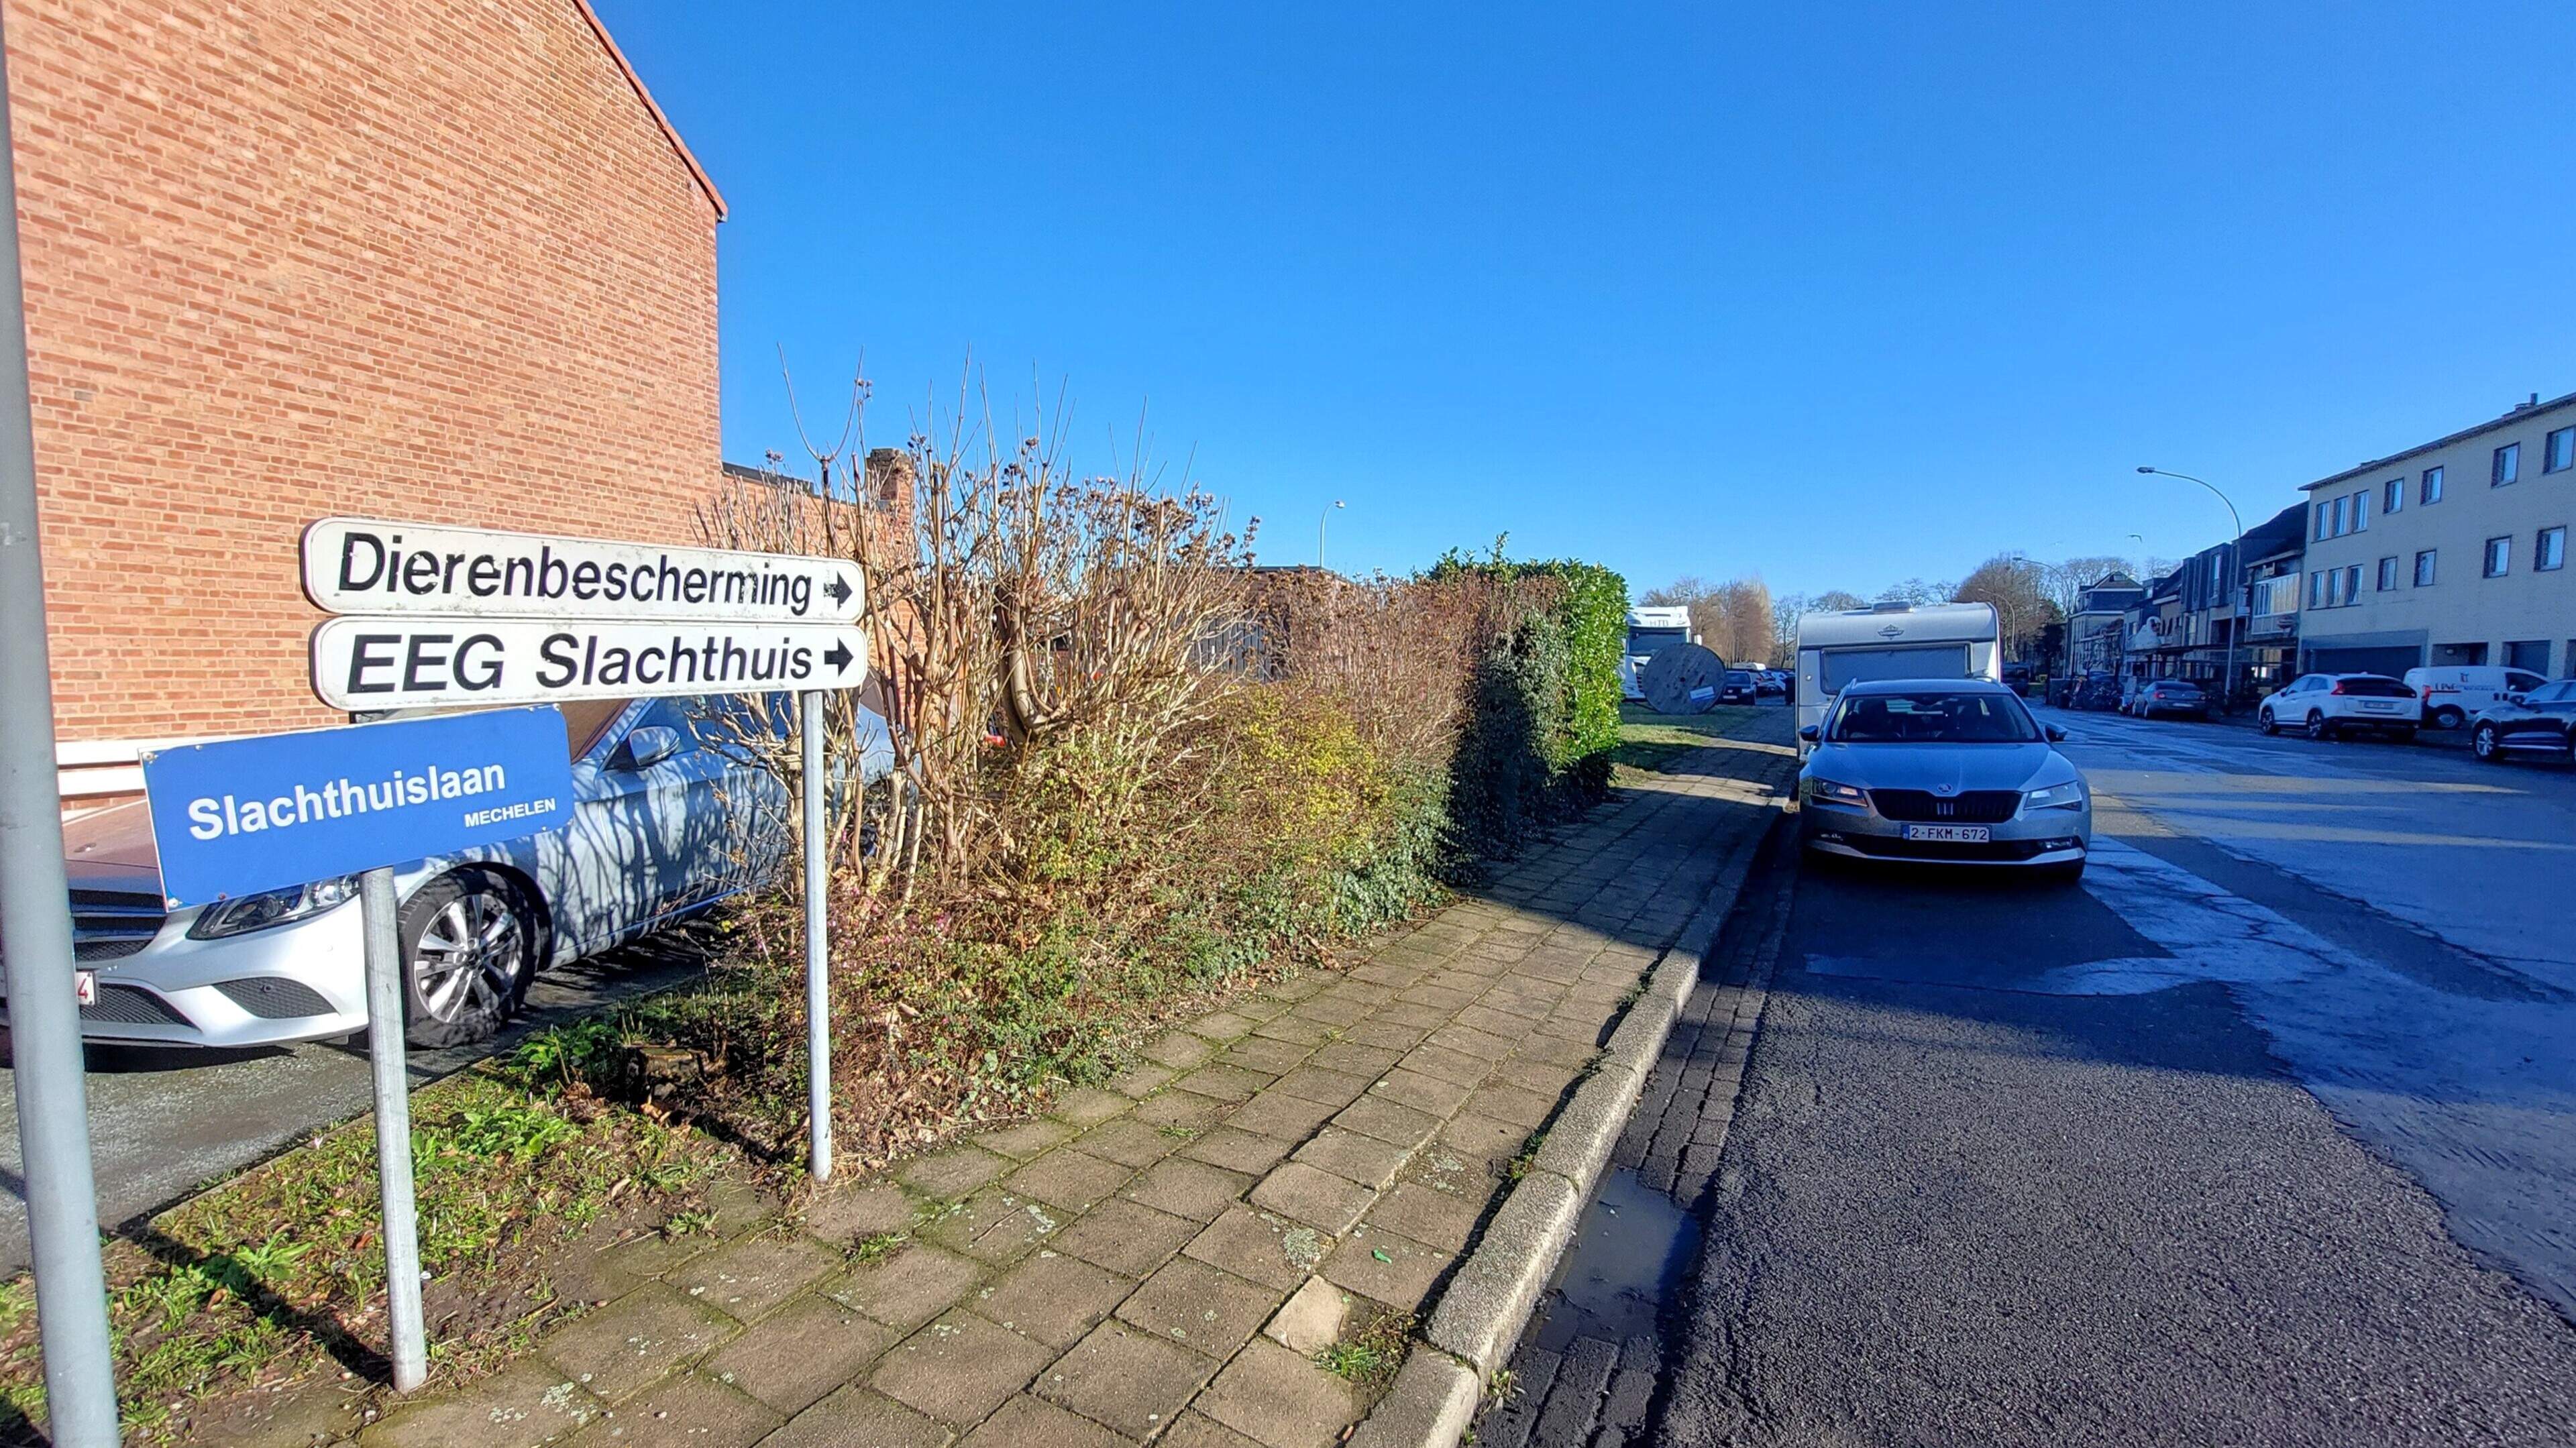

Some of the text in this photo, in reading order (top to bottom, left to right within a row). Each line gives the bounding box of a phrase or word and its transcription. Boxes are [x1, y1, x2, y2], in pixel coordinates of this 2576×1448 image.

[339, 532, 812, 615] Dierenbescherming
[347, 632, 812, 694] EEG Slachthuis
[188, 764, 506, 840] Slachthuislaan
[464, 798, 556, 828] MECHELEN
[1911, 827, 1987, 840] 2-FKM-672
